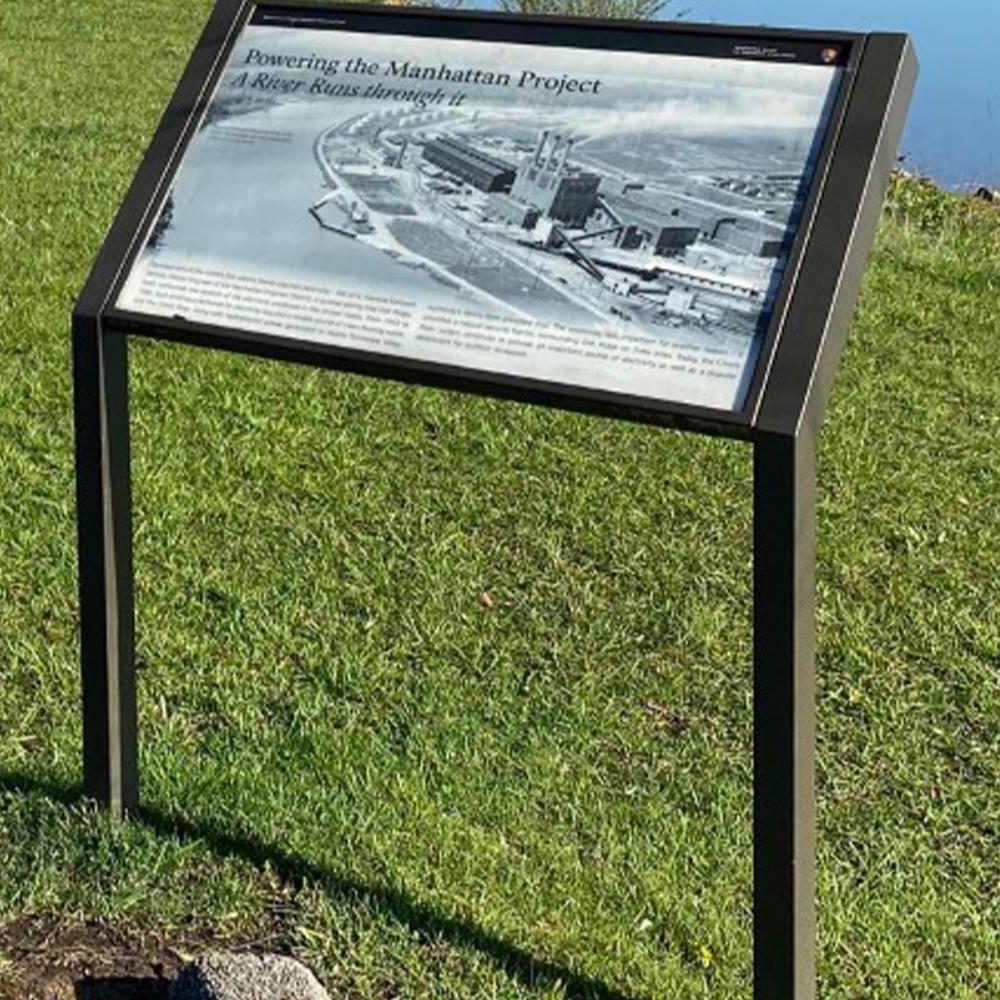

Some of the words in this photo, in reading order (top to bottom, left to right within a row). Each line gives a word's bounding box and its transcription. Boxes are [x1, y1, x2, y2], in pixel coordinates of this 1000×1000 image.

[230, 72, 248, 88] A
[251, 72, 306, 93] River
[310, 77, 361, 98] Runs
[363, 83, 445, 109] through
[448, 90, 467, 106] it
[244, 49, 339, 76] Powering
[345, 57, 379, 76] the
[385, 60, 511, 87] Manhattan
[518, 70, 603, 96] Project
